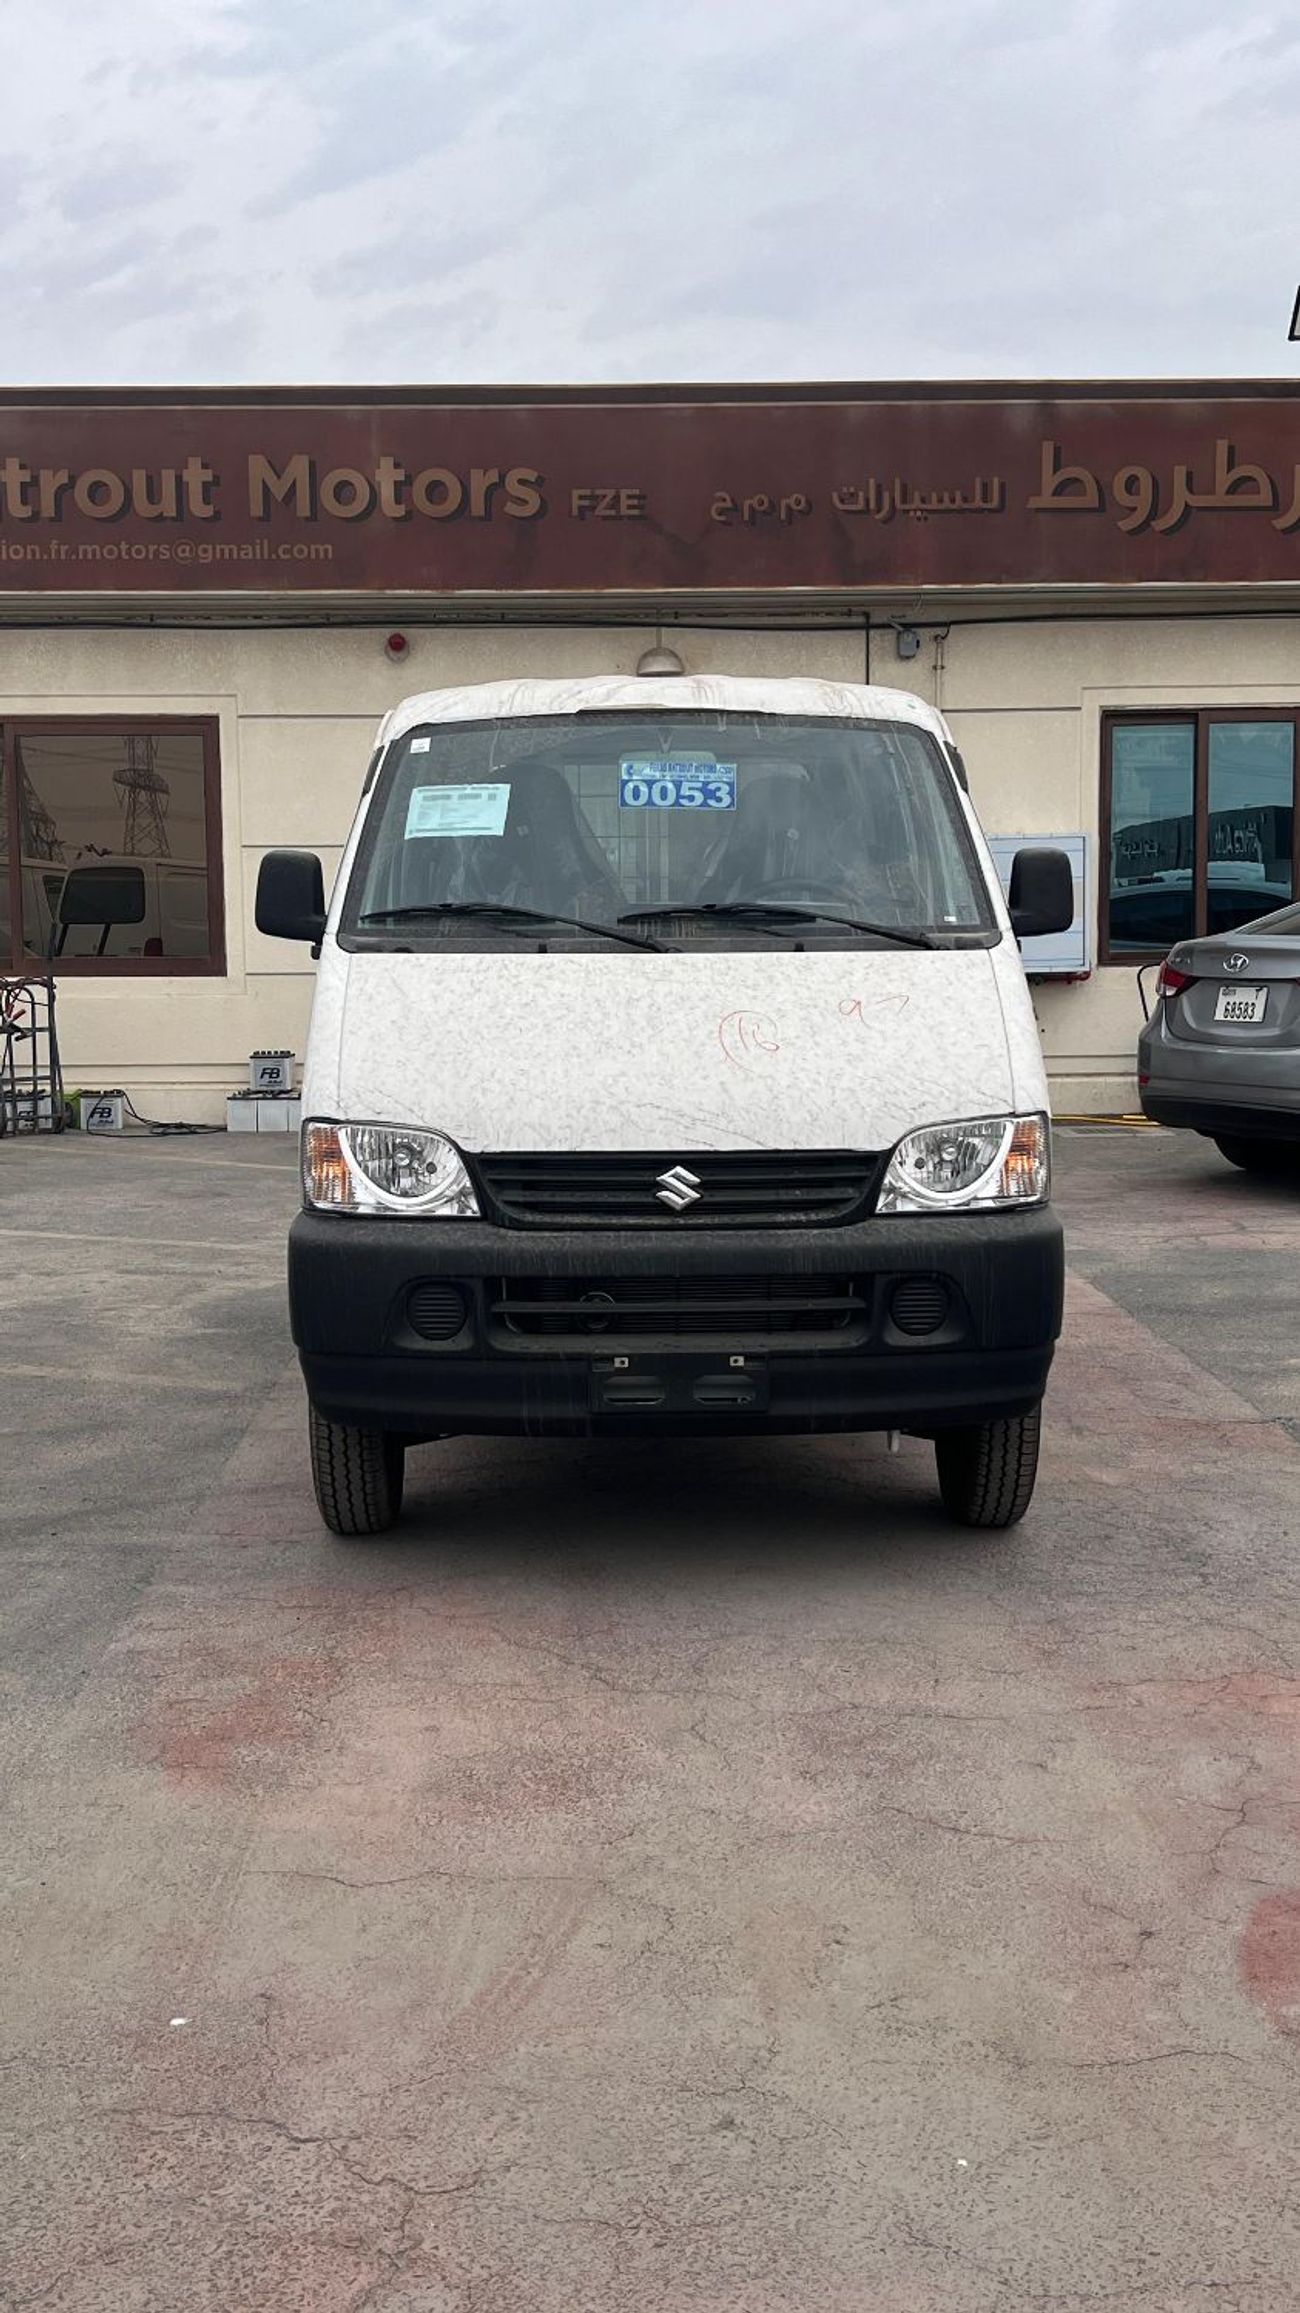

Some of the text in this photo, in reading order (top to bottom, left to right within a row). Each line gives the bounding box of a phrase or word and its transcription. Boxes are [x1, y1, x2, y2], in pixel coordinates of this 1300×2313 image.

[0, 454, 642, 519] trout Motors FZE
[832, 476, 999, 520] للسيارات
[0, 537, 333, 565] ion.fr.motors@gmail.com
[623, 780, 732, 808] 0053
[1223, 1001, 1256, 1019] 68583
[260, 1067, 280, 1079] FB
